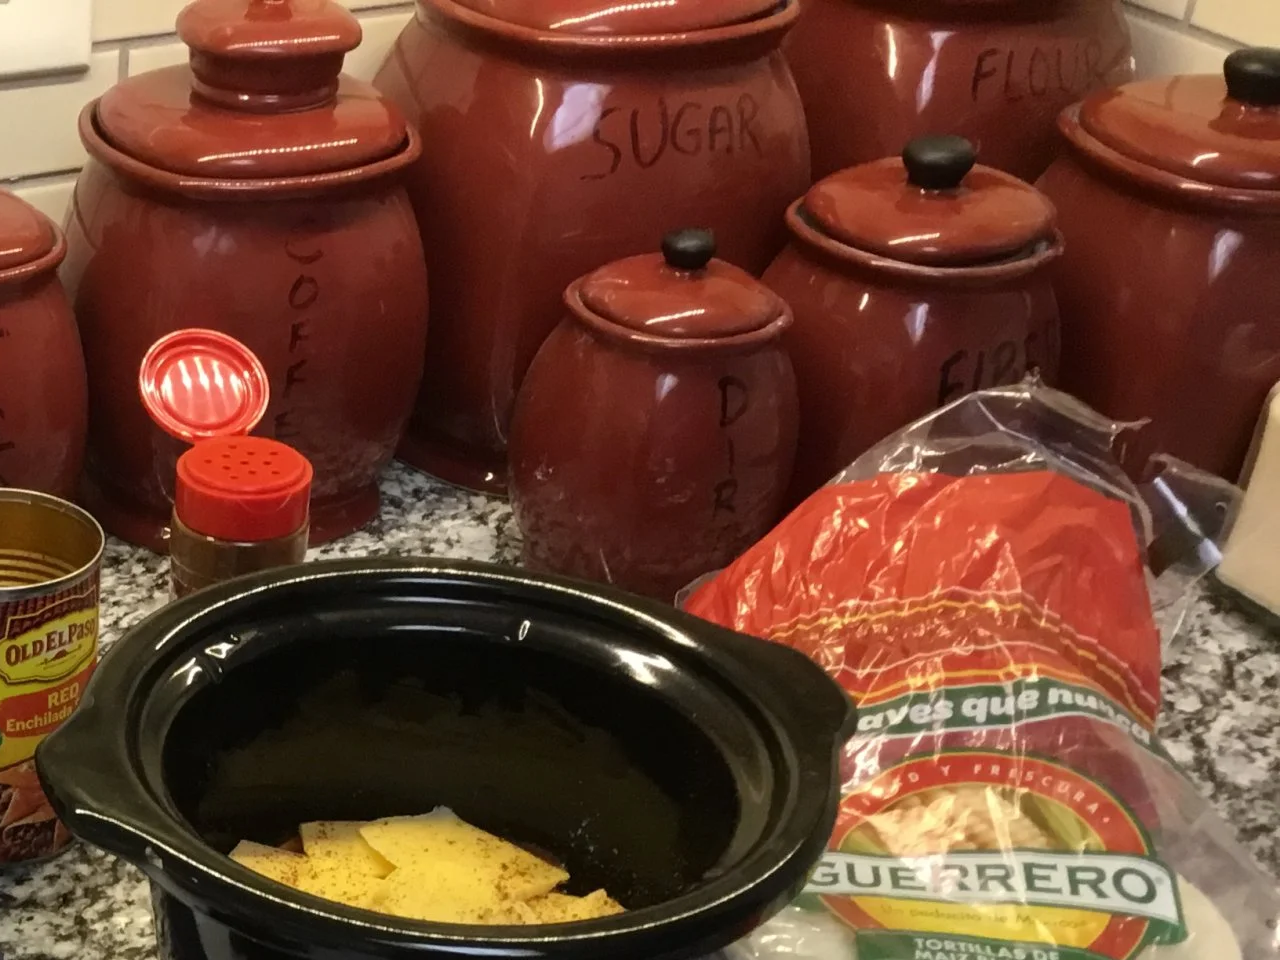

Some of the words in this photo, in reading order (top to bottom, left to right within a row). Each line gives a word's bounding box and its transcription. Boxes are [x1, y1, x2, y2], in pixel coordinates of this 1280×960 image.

[580, 92, 763, 181] SUGAR
[274, 214, 324, 438] COFFE
[48, 682, 80, 709] RED
[856, 698, 954, 731] aves
[961, 687, 1040, 723] que
[973, 763, 1100, 815] FRESCURA
[809, 860, 1158, 905] GUERRERO
